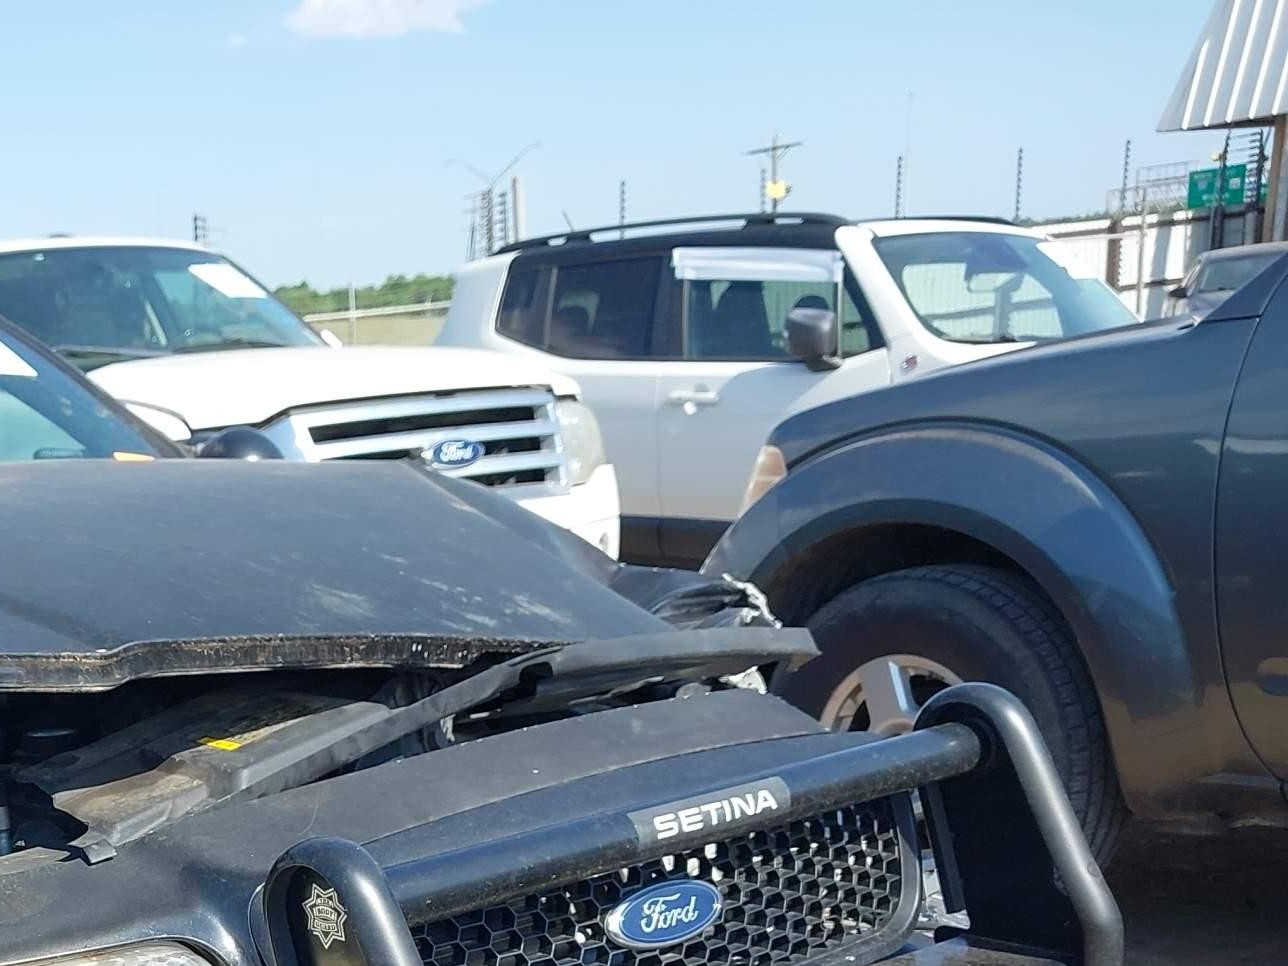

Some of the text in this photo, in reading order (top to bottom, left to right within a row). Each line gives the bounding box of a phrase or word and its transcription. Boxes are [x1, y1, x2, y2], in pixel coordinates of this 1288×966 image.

[440, 441, 475, 462] Ford
[653, 789, 778, 840] SETINA
[640, 893, 700, 933] Ford
